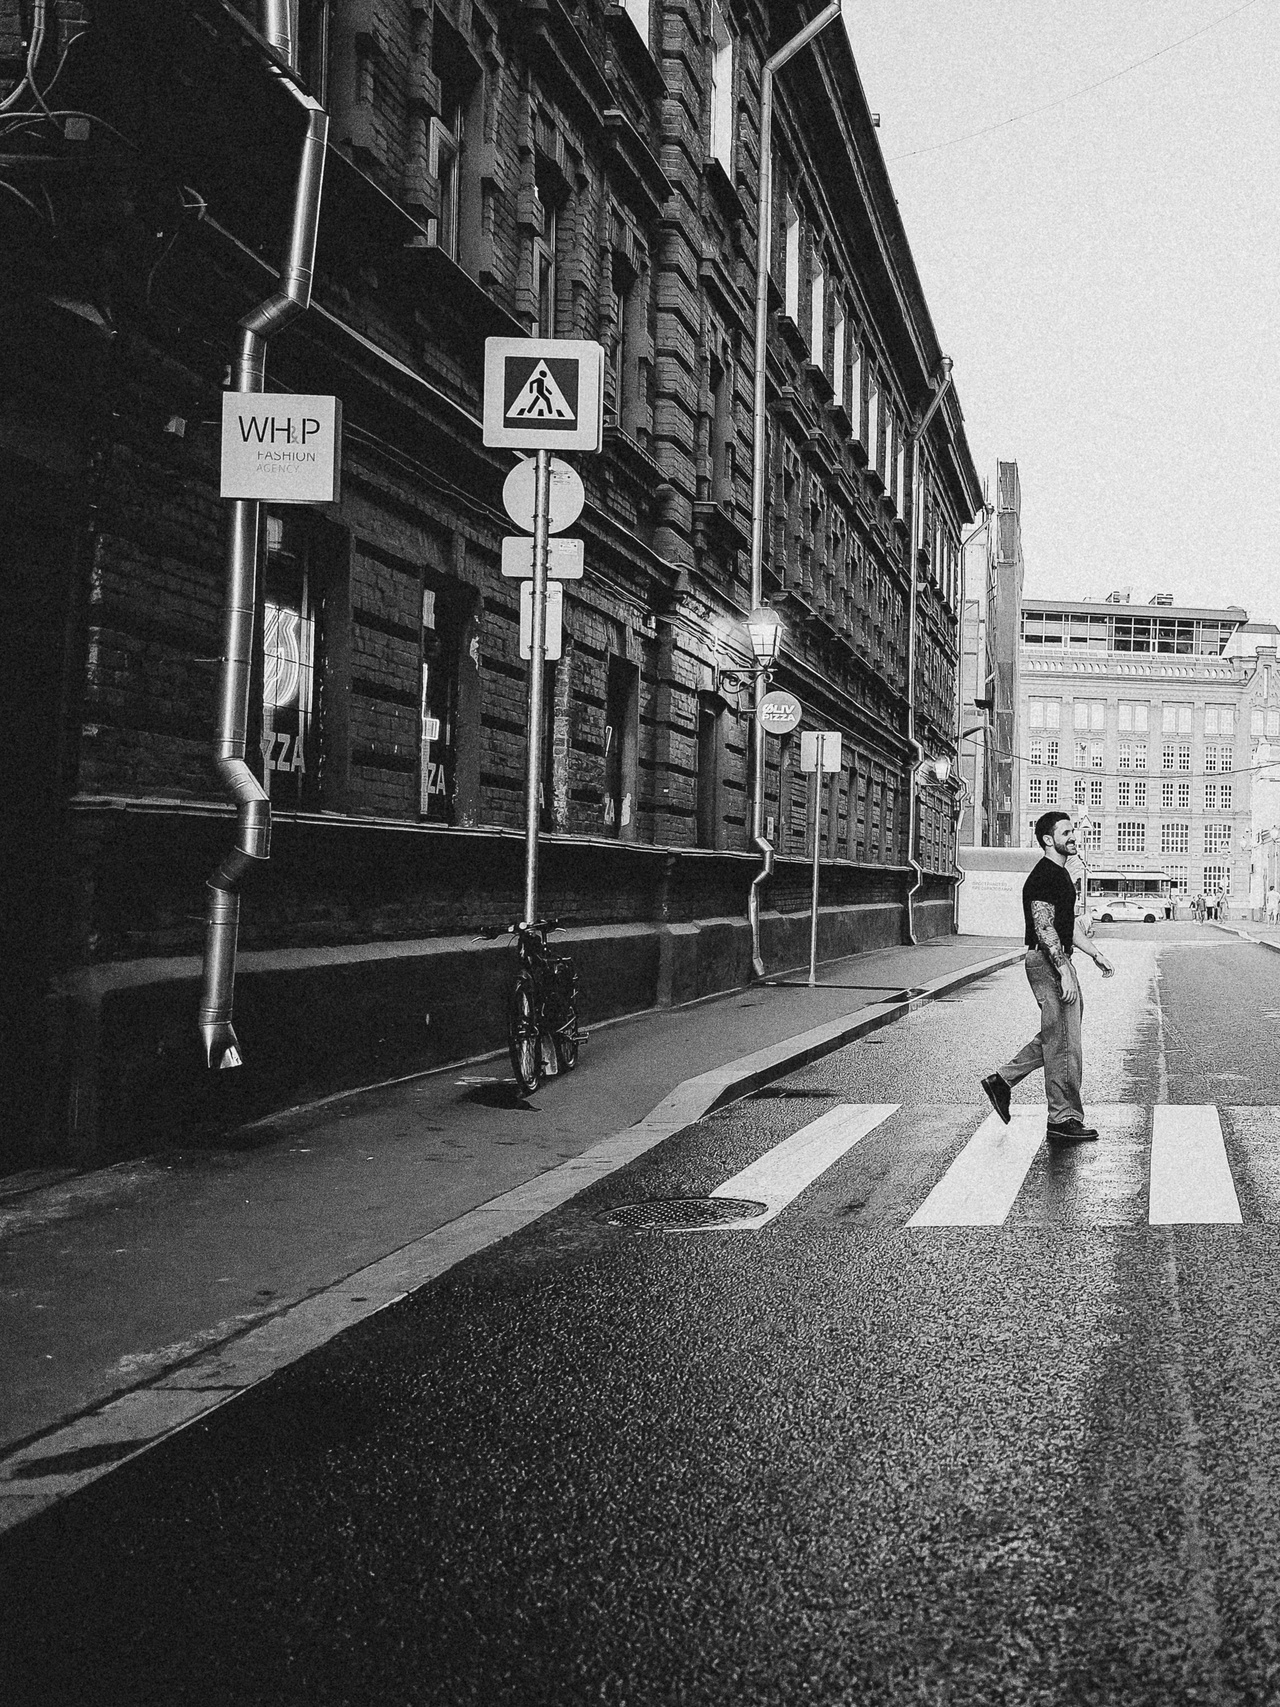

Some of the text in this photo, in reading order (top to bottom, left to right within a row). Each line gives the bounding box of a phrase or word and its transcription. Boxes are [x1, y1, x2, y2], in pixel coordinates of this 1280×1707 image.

[257, 450, 316, 462] FASHION
[256, 462, 300, 474] AGENCY
[762, 713, 796, 722] PIZZA
